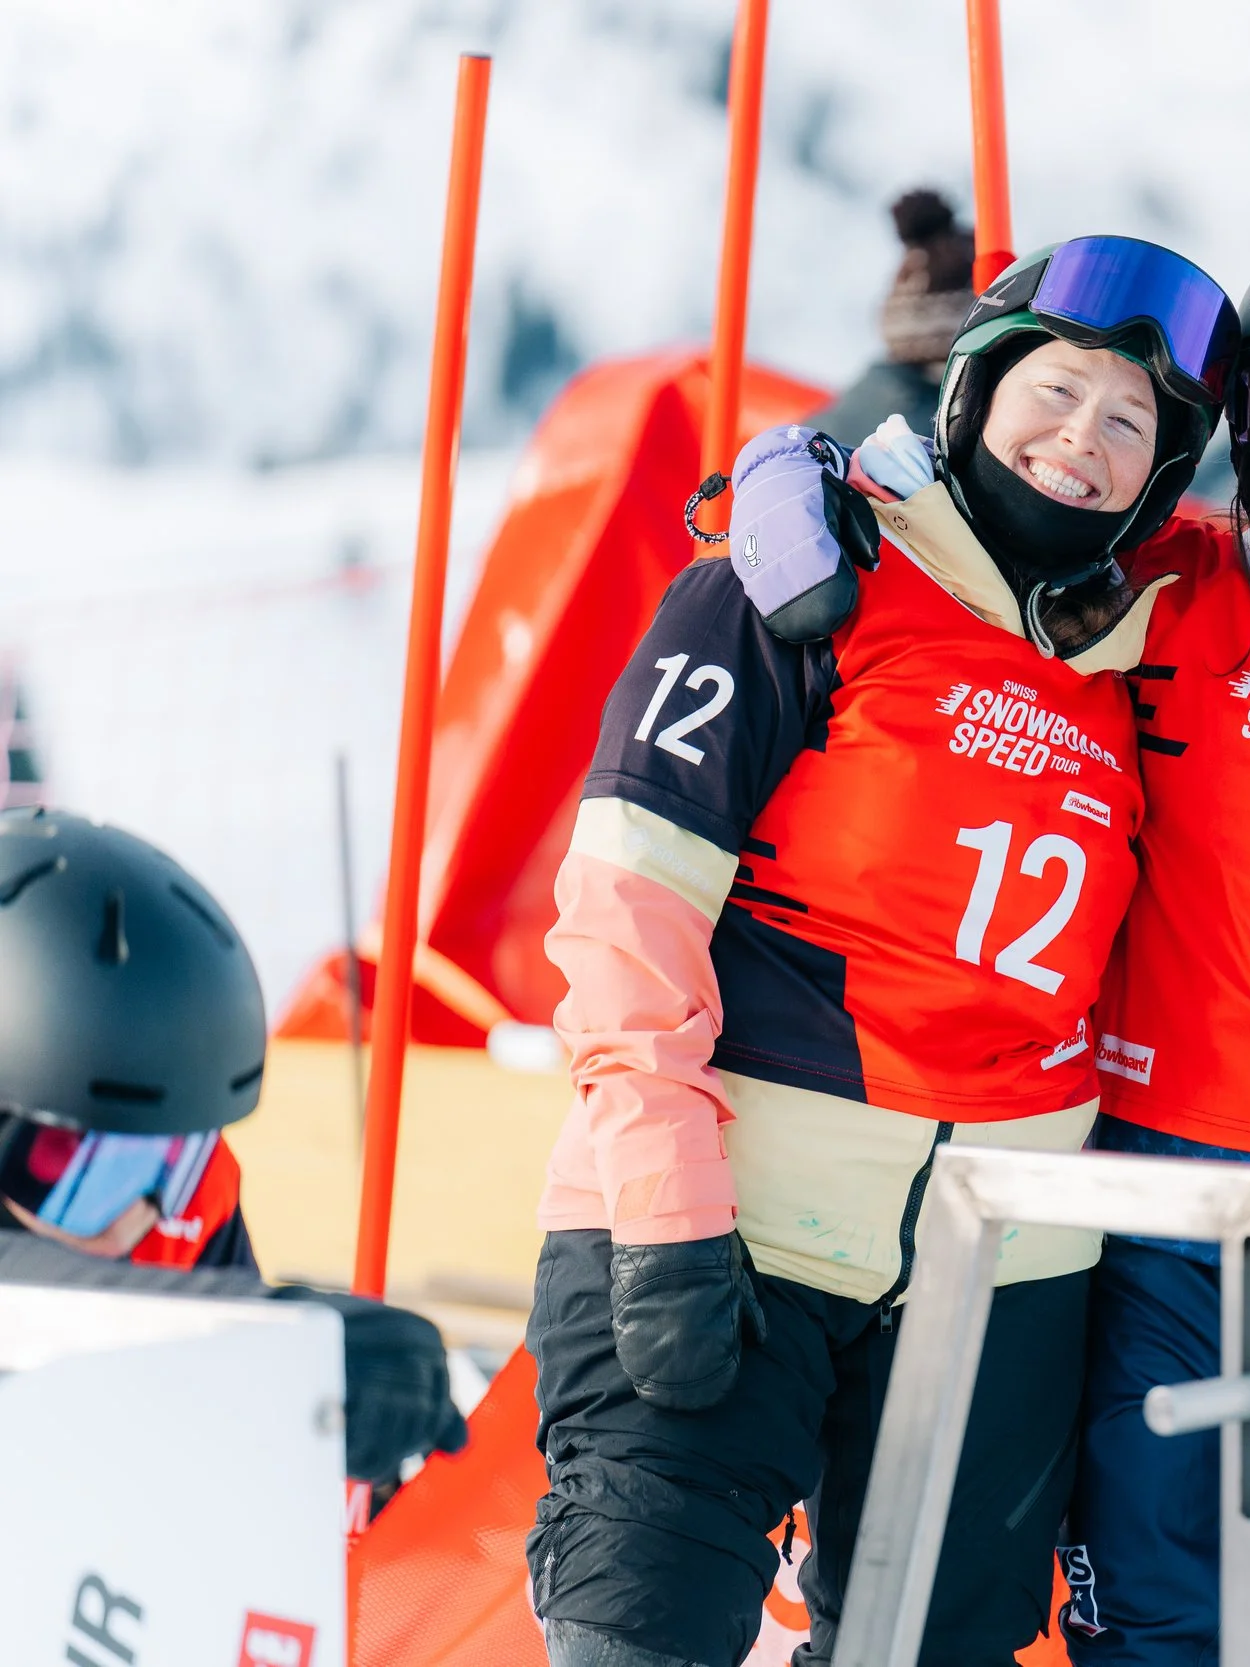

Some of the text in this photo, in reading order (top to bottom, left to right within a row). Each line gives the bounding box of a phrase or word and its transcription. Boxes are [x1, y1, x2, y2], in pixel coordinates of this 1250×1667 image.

[634, 652, 735, 767] 12
[1002, 679, 1038, 702] SWISS
[949, 722, 1081, 777] SPEED TOUR
[955, 820, 1087, 996] 12
